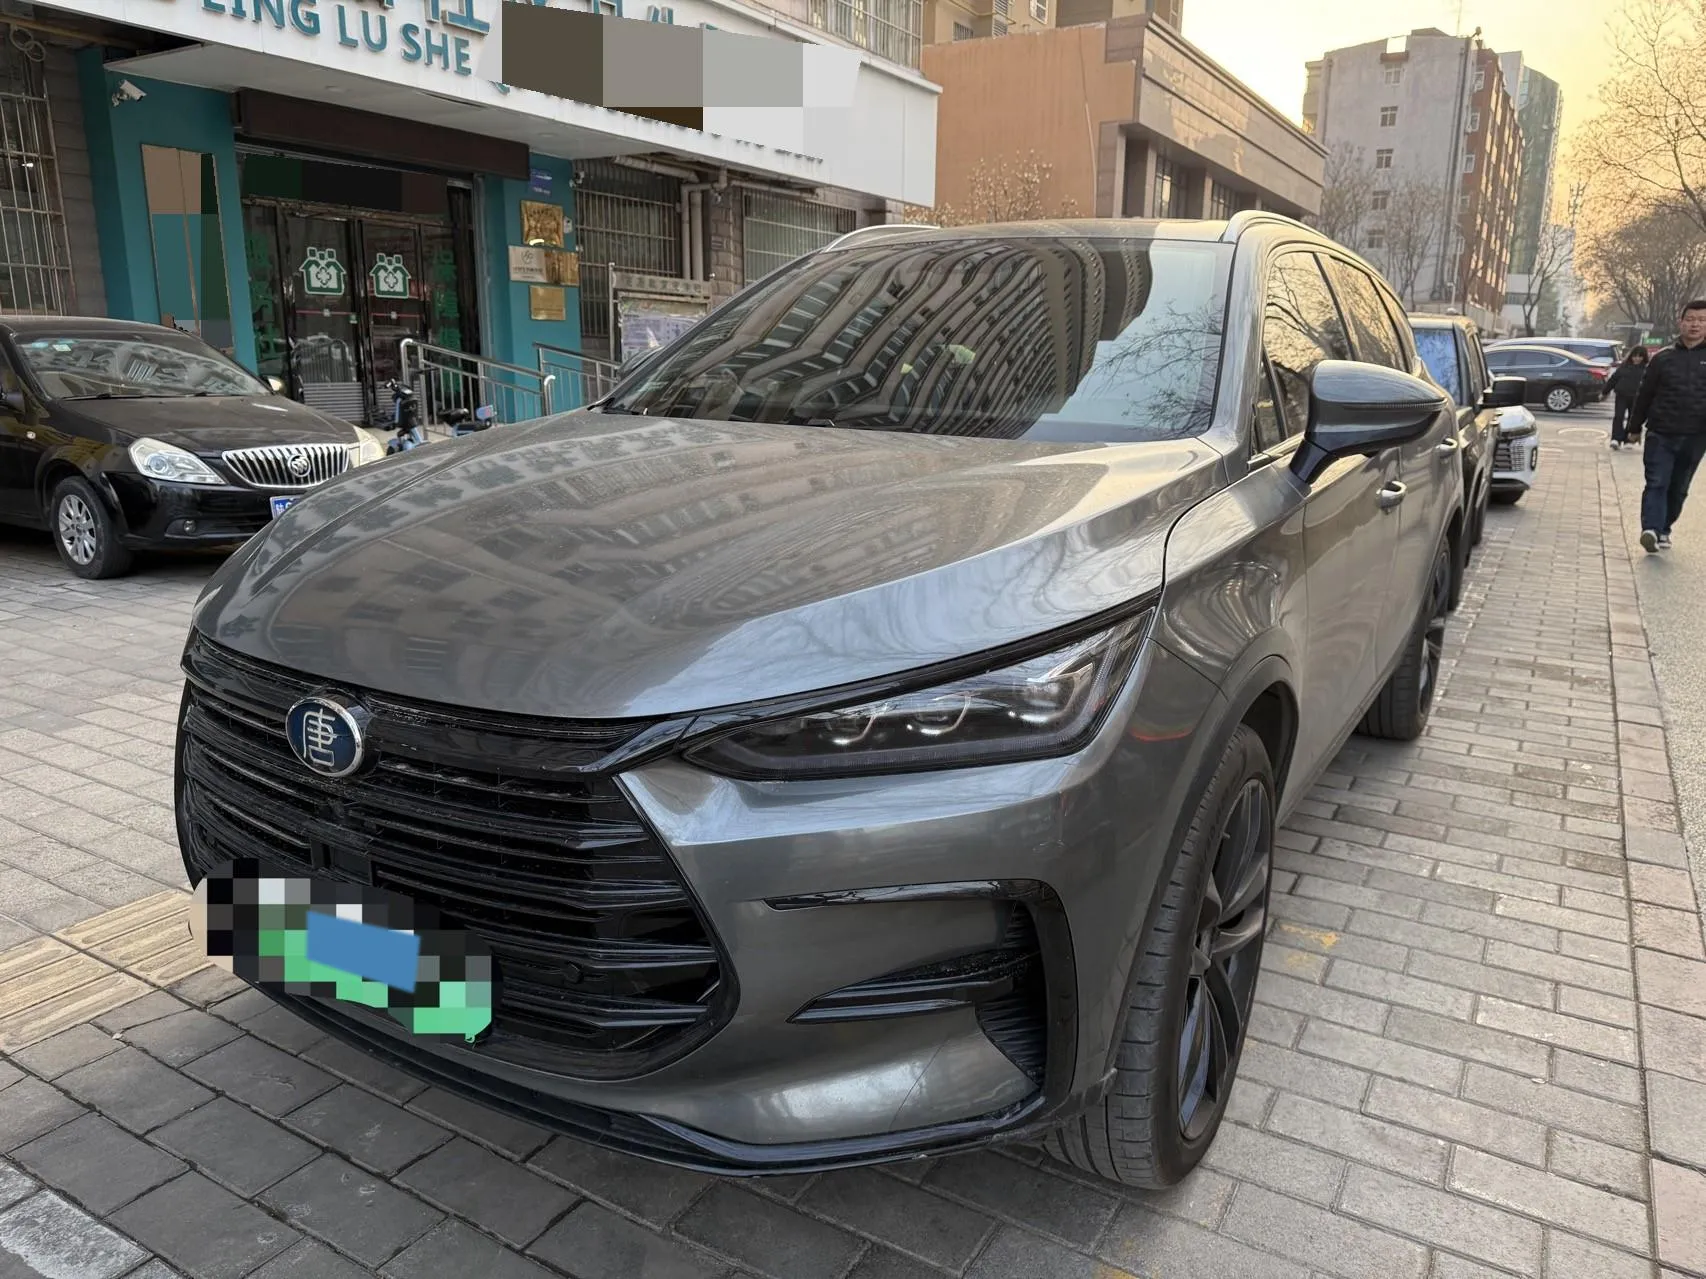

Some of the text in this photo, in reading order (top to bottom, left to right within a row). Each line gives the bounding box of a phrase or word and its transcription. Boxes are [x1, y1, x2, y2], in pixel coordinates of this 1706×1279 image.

[201, 0, 320, 36] NG
[337, 4, 387, 52] LU
[401, 23, 471, 76] SHE
